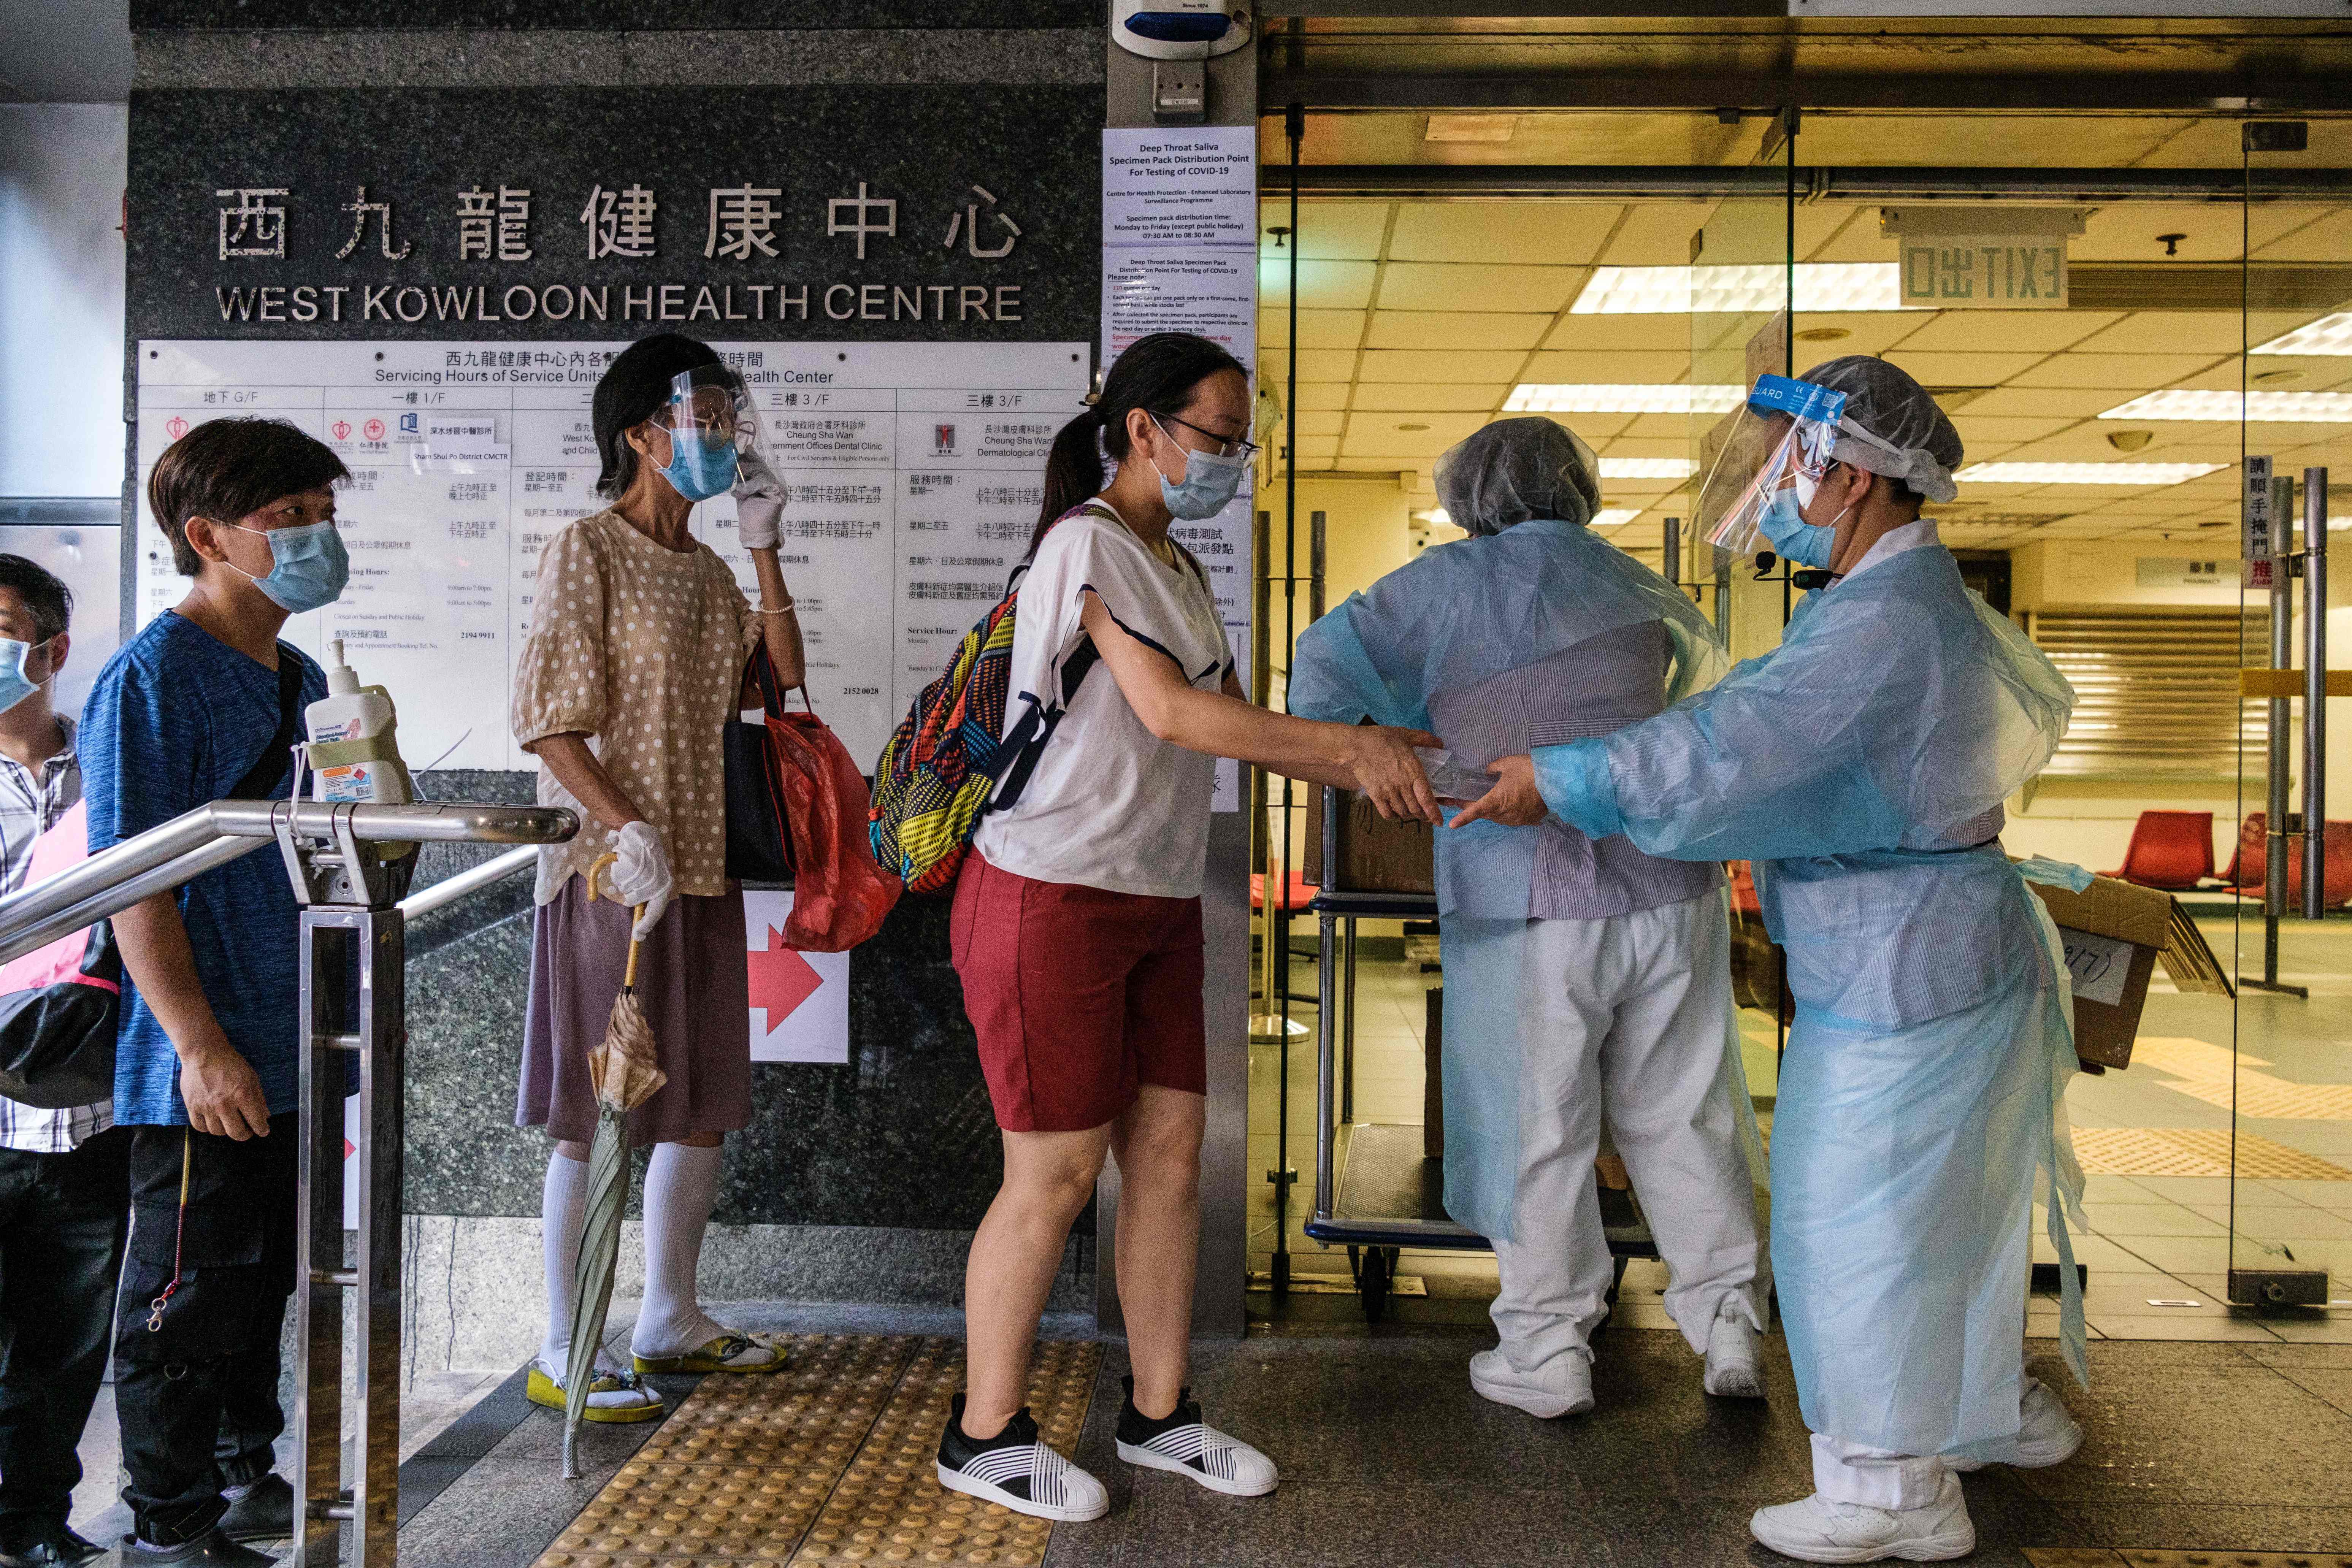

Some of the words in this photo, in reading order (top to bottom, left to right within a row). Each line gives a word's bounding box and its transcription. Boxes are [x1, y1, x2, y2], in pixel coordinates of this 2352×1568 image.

[1110, 157, 1150, 166] Specimen
[1145, 168, 1175, 176] Testing
[216, 182, 1022, 260] 西九龍健康中心
[216, 285, 349, 322] WEST
[364, 285, 607, 322] KOWLOON
[625, 285, 808, 320] HEALTH
[825, 284, 1022, 320] CENTRE
[375, 369, 441, 384] Servicing
[446, 369, 488, 382] Hours
[492, 369, 506, 381] of
[510, 369, 563, 382] Service
[568, 370, 604, 382] Units
[745, 371, 779, 383] ealth
[784, 371, 833, 383] Center
[204, 391, 229, 403] 地下
[234, 391, 258, 403] G/F
[392, 392, 418, 404] 一樓
[424, 392, 446, 404] 1/F
[771, 393, 797, 406] 三樓
[966, 395, 993, 407] 三樓
[999, 396, 1022, 407] 3/F
[563, 434, 582, 442] West
[787, 431, 817, 440] Cheung
[985, 437, 1015, 445] Cheung
[978, 449, 1035, 458] Dermatological
